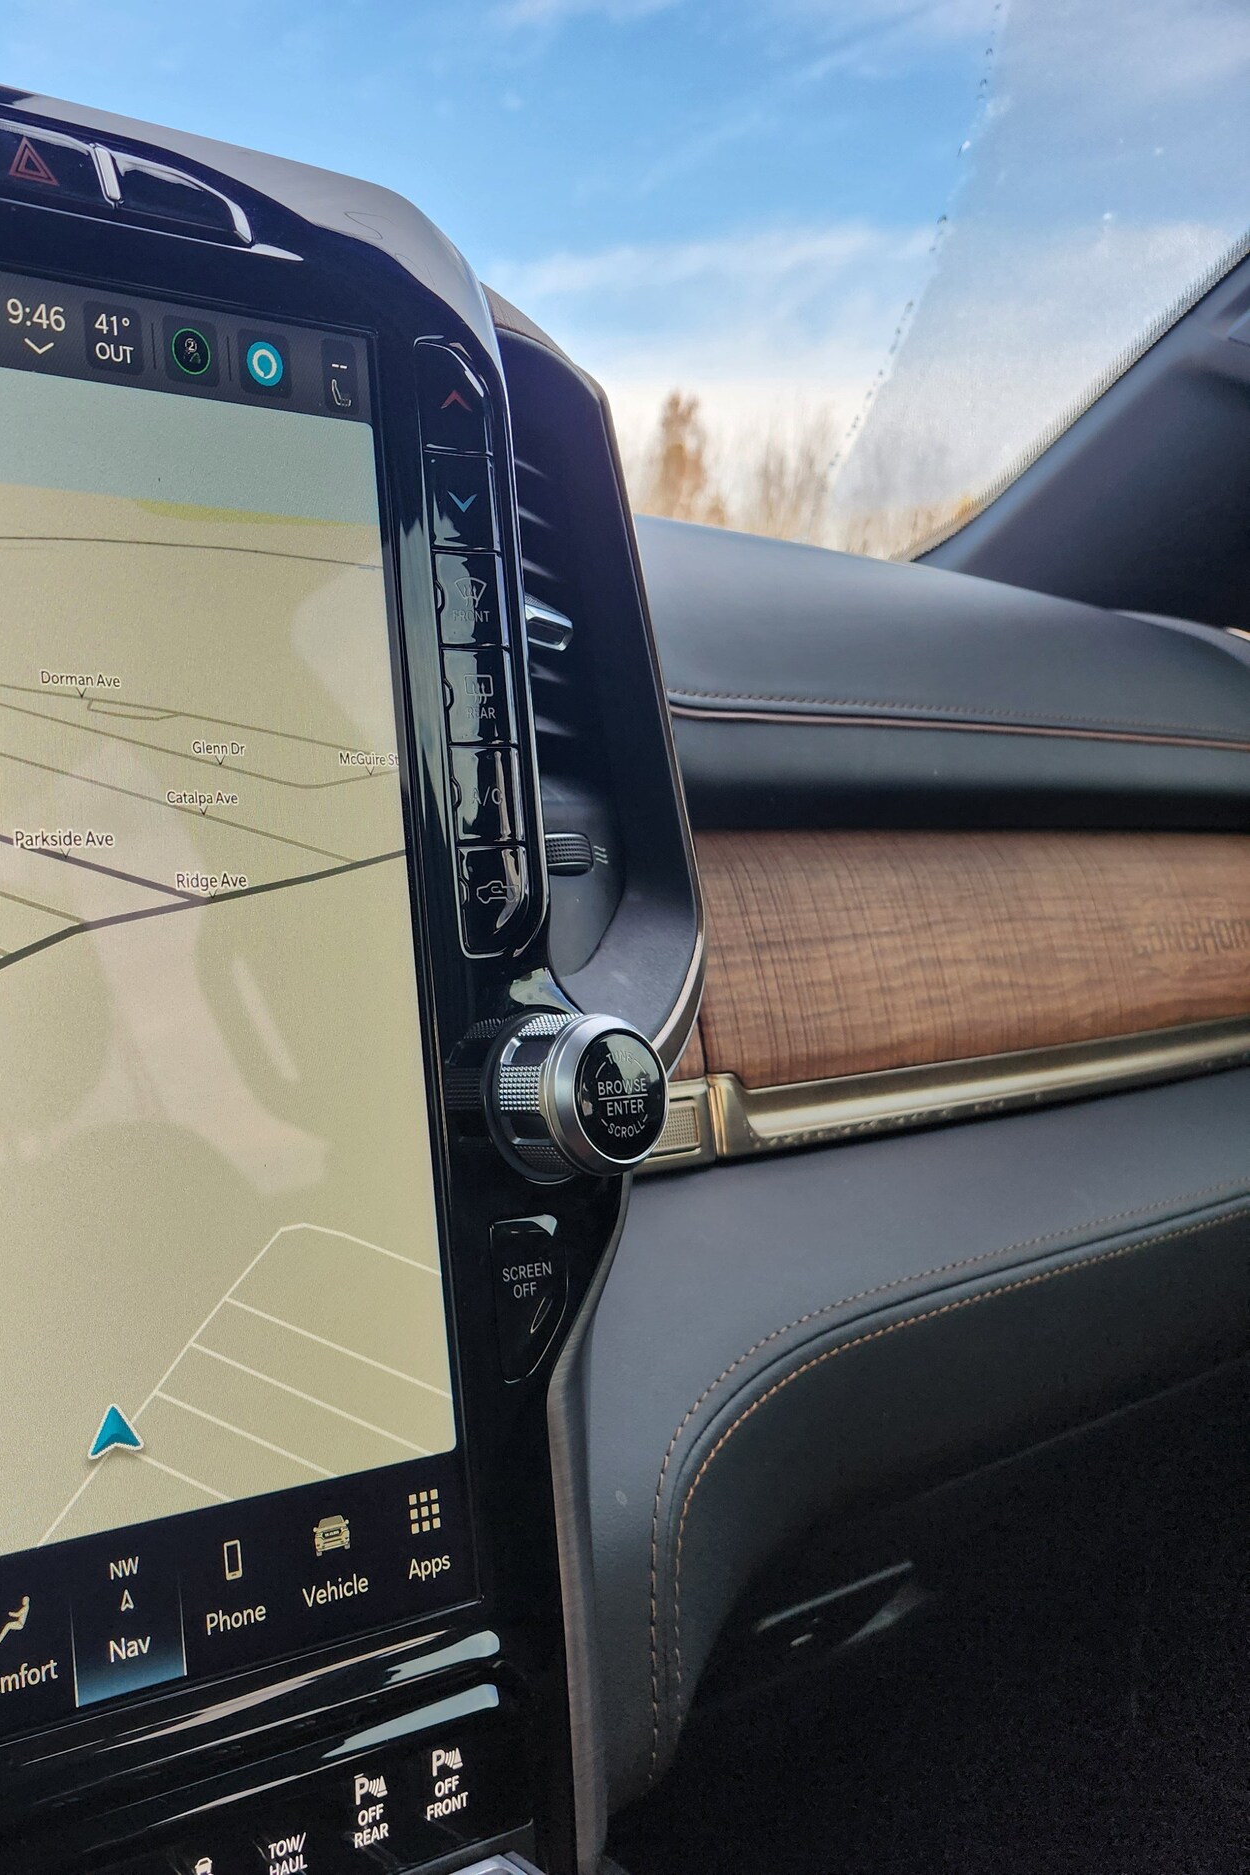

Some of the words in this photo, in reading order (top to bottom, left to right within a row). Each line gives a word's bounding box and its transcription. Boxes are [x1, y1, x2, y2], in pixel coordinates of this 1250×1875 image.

[7, 298, 66, 332] 9:46
[94, 313, 130, 336] 41°
[95, 342, 134, 364] OUT
[452, 609, 490, 623] FRONT
[40, 670, 93, 688] Dorman
[96, 672, 121, 688] Ave
[467, 706, 497, 720] REAR
[191, 740, 228, 756] Glenn
[231, 743, 246, 756] Dr
[339, 752, 386, 766] McGuire
[387, 753, 400, 766] St
[166, 791, 213, 807] Catalpa
[215, 792, 238, 806] Ave
[472, 786, 503, 806] A/C
[14, 831, 82, 848] Parkside
[85, 832, 114, 848] Ave
[175, 873, 218, 893] Ridge
[220, 874, 247, 889] Ave
[606, 1050, 633, 1065] TUNE
[597, 1078, 648, 1096] BROWSE
[606, 1099, 645, 1117] ENTER
[607, 1120, 646, 1139] SCROLL
[502, 1261, 553, 1283] SCREEN
[513, 1282, 538, 1300] OFF
[109, 1555, 140, 1581] NW
[408, 1553, 451, 1581] Apps
[302, 1573, 369, 1609] Vehicle
[205, 1602, 267, 1636] Phone
[109, 1635, 152, 1663] Nav
[434, 1775, 459, 1799] OFF
[357, 1803, 384, 1828] OFF
[426, 1791, 469, 1822] FRONT
[267, 1831, 307, 1860] TOW/
[353, 1822, 390, 1849] REAR
[269, 1853, 308, 1875] HAUL
